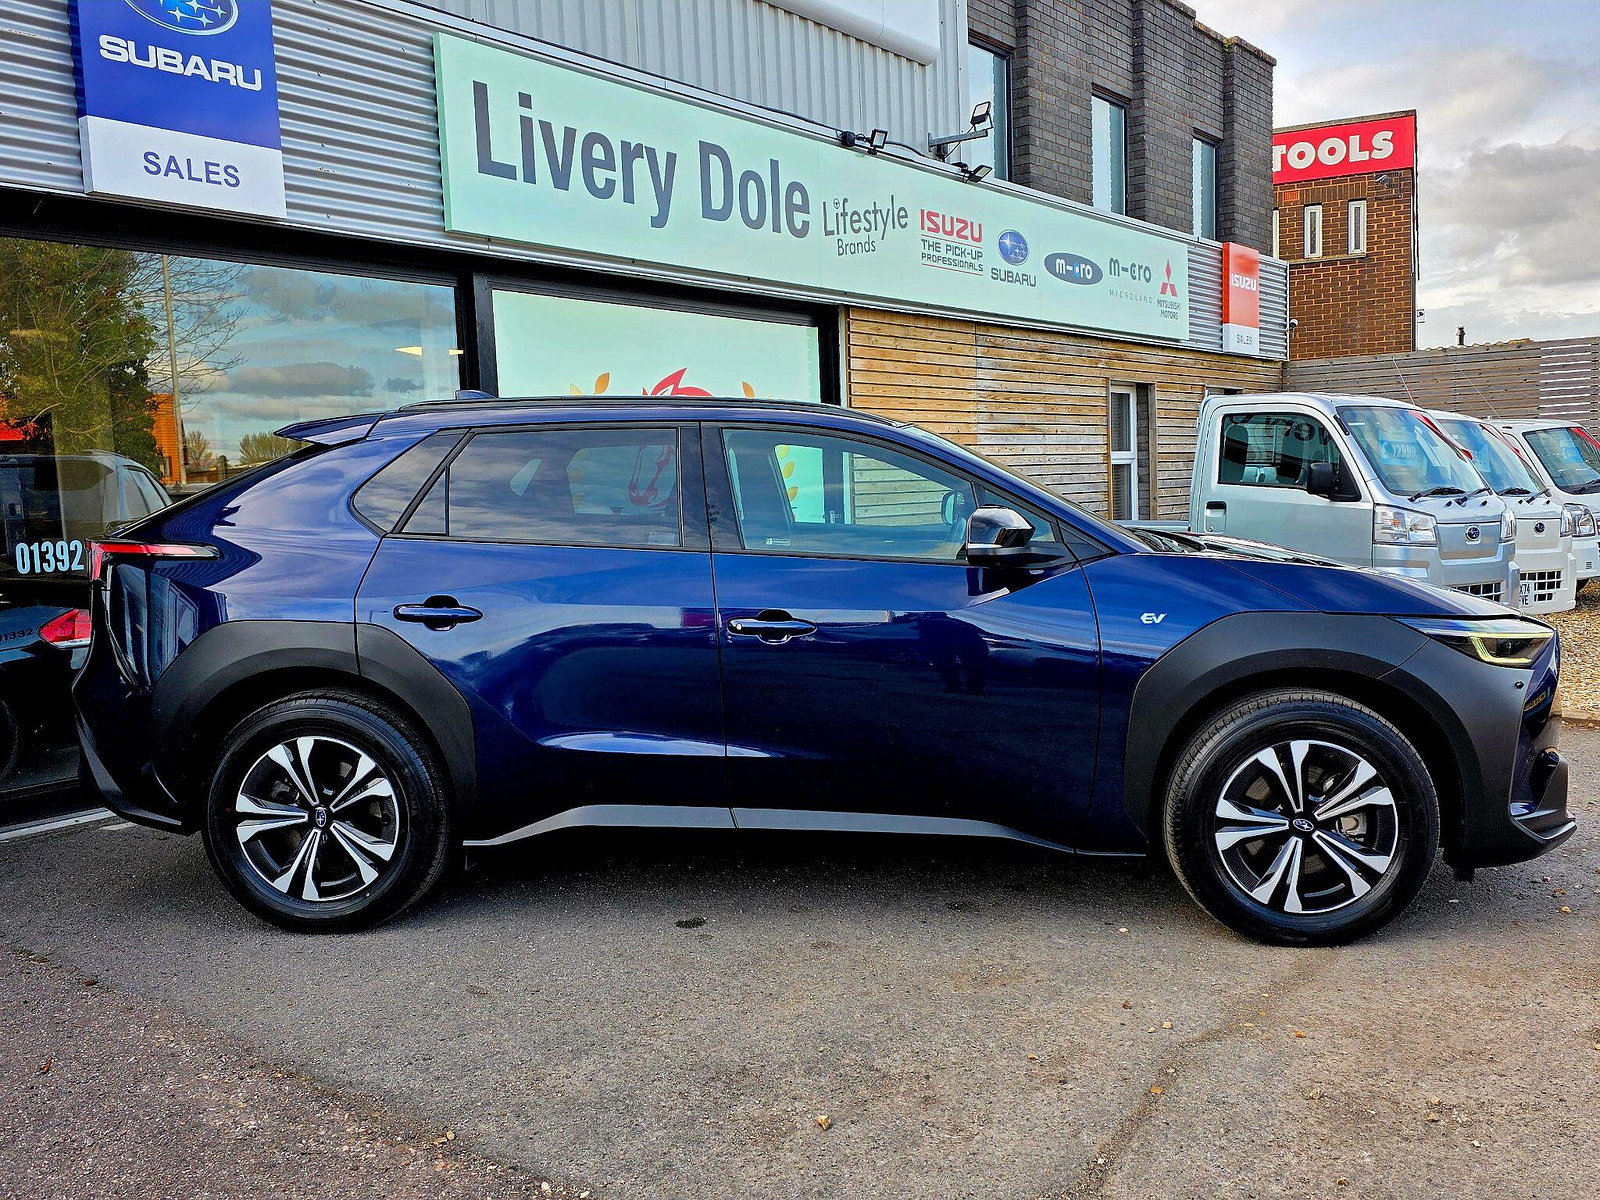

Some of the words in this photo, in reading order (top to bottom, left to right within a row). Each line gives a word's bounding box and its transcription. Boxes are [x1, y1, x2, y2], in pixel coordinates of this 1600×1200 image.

[99, 34, 261, 91] SUBARU
[473, 80, 677, 228] Livery
[698, 140, 810, 238] Dole
[1272, 131, 1394, 172] TOOLS
[143, 151, 241, 188] SALES
[823, 195, 908, 240] Lifestyle
[920, 209, 983, 243] ISUZU
[837, 234, 876, 256] Brands
[921, 238, 942, 253] THE
[945, 243, 983, 261] PICK-UP
[921, 253, 983, 272] PROFESSIONALS
[991, 267, 1037, 288] SUBARU
[1231, 273, 1257, 291] ISUZU
[1161, 309, 1180, 320] MOTORS
[1236, 334, 1253, 345] SALES
[15, 540, 84, 574] 01392
[1140, 612, 1167, 624] EV
[0, 628, 34, 641] 1392
